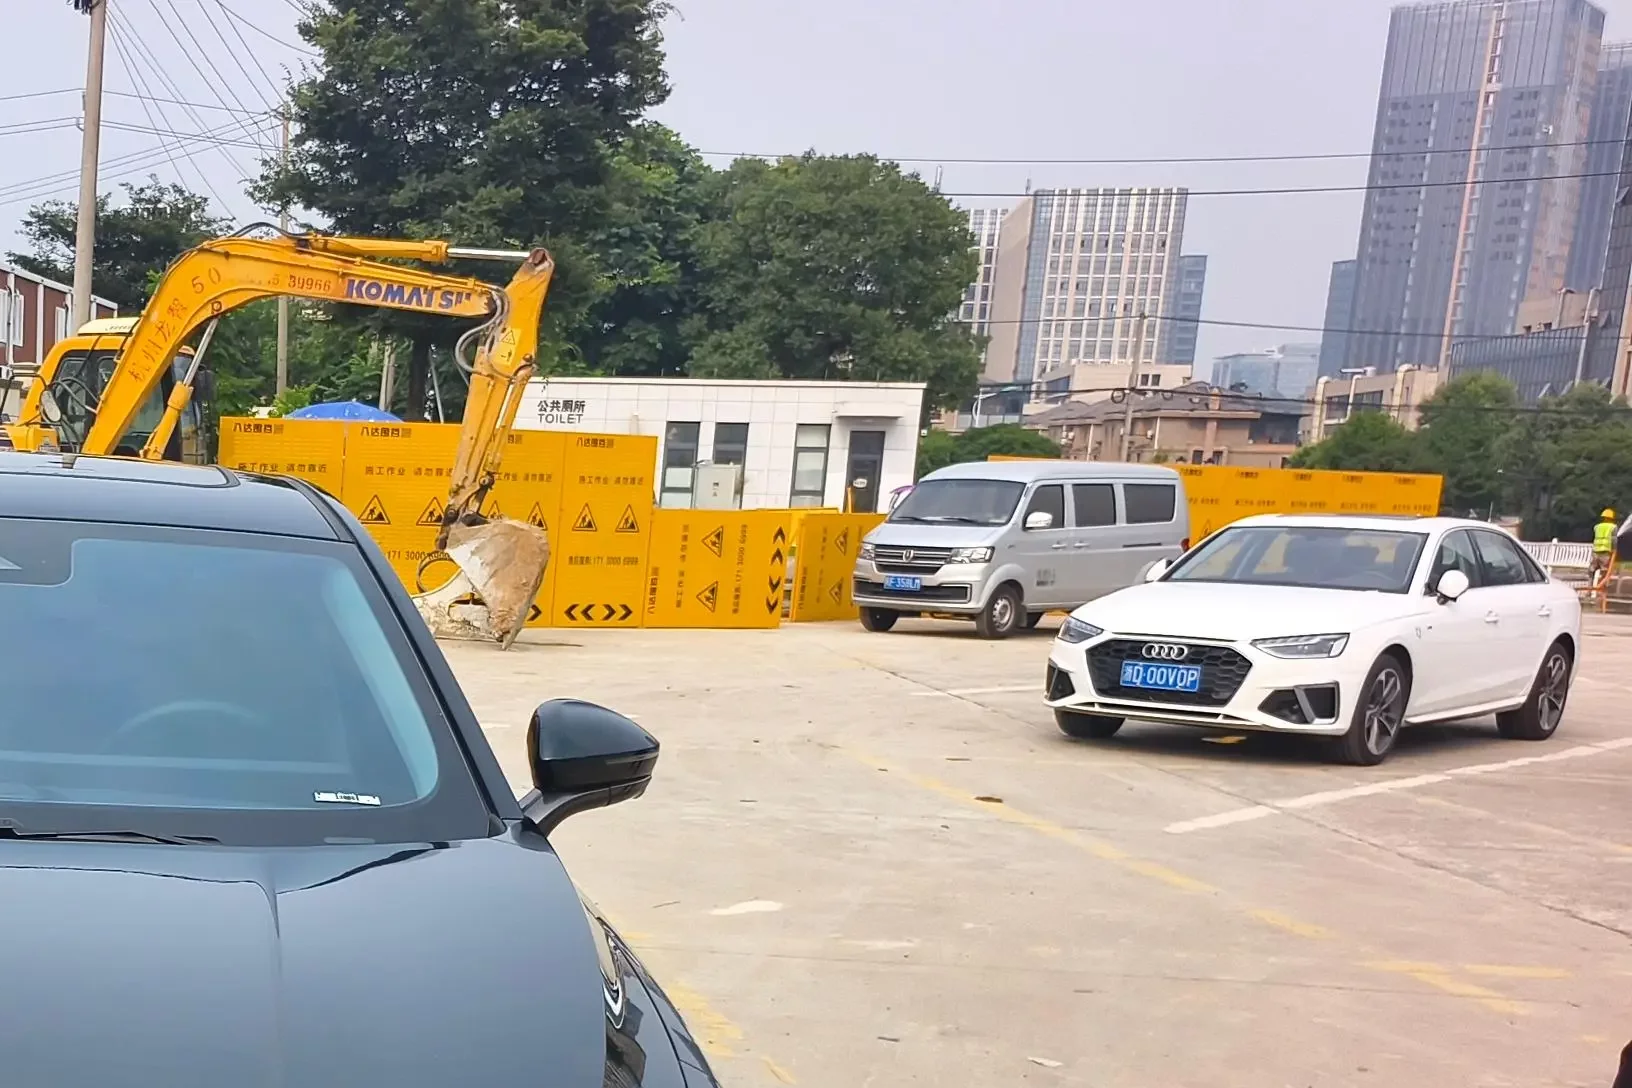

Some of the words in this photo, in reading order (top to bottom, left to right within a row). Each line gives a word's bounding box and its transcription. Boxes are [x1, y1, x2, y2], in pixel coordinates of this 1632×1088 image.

[536, 399, 586, 412] 公共厕所
[537, 413, 584, 424] TOILET
